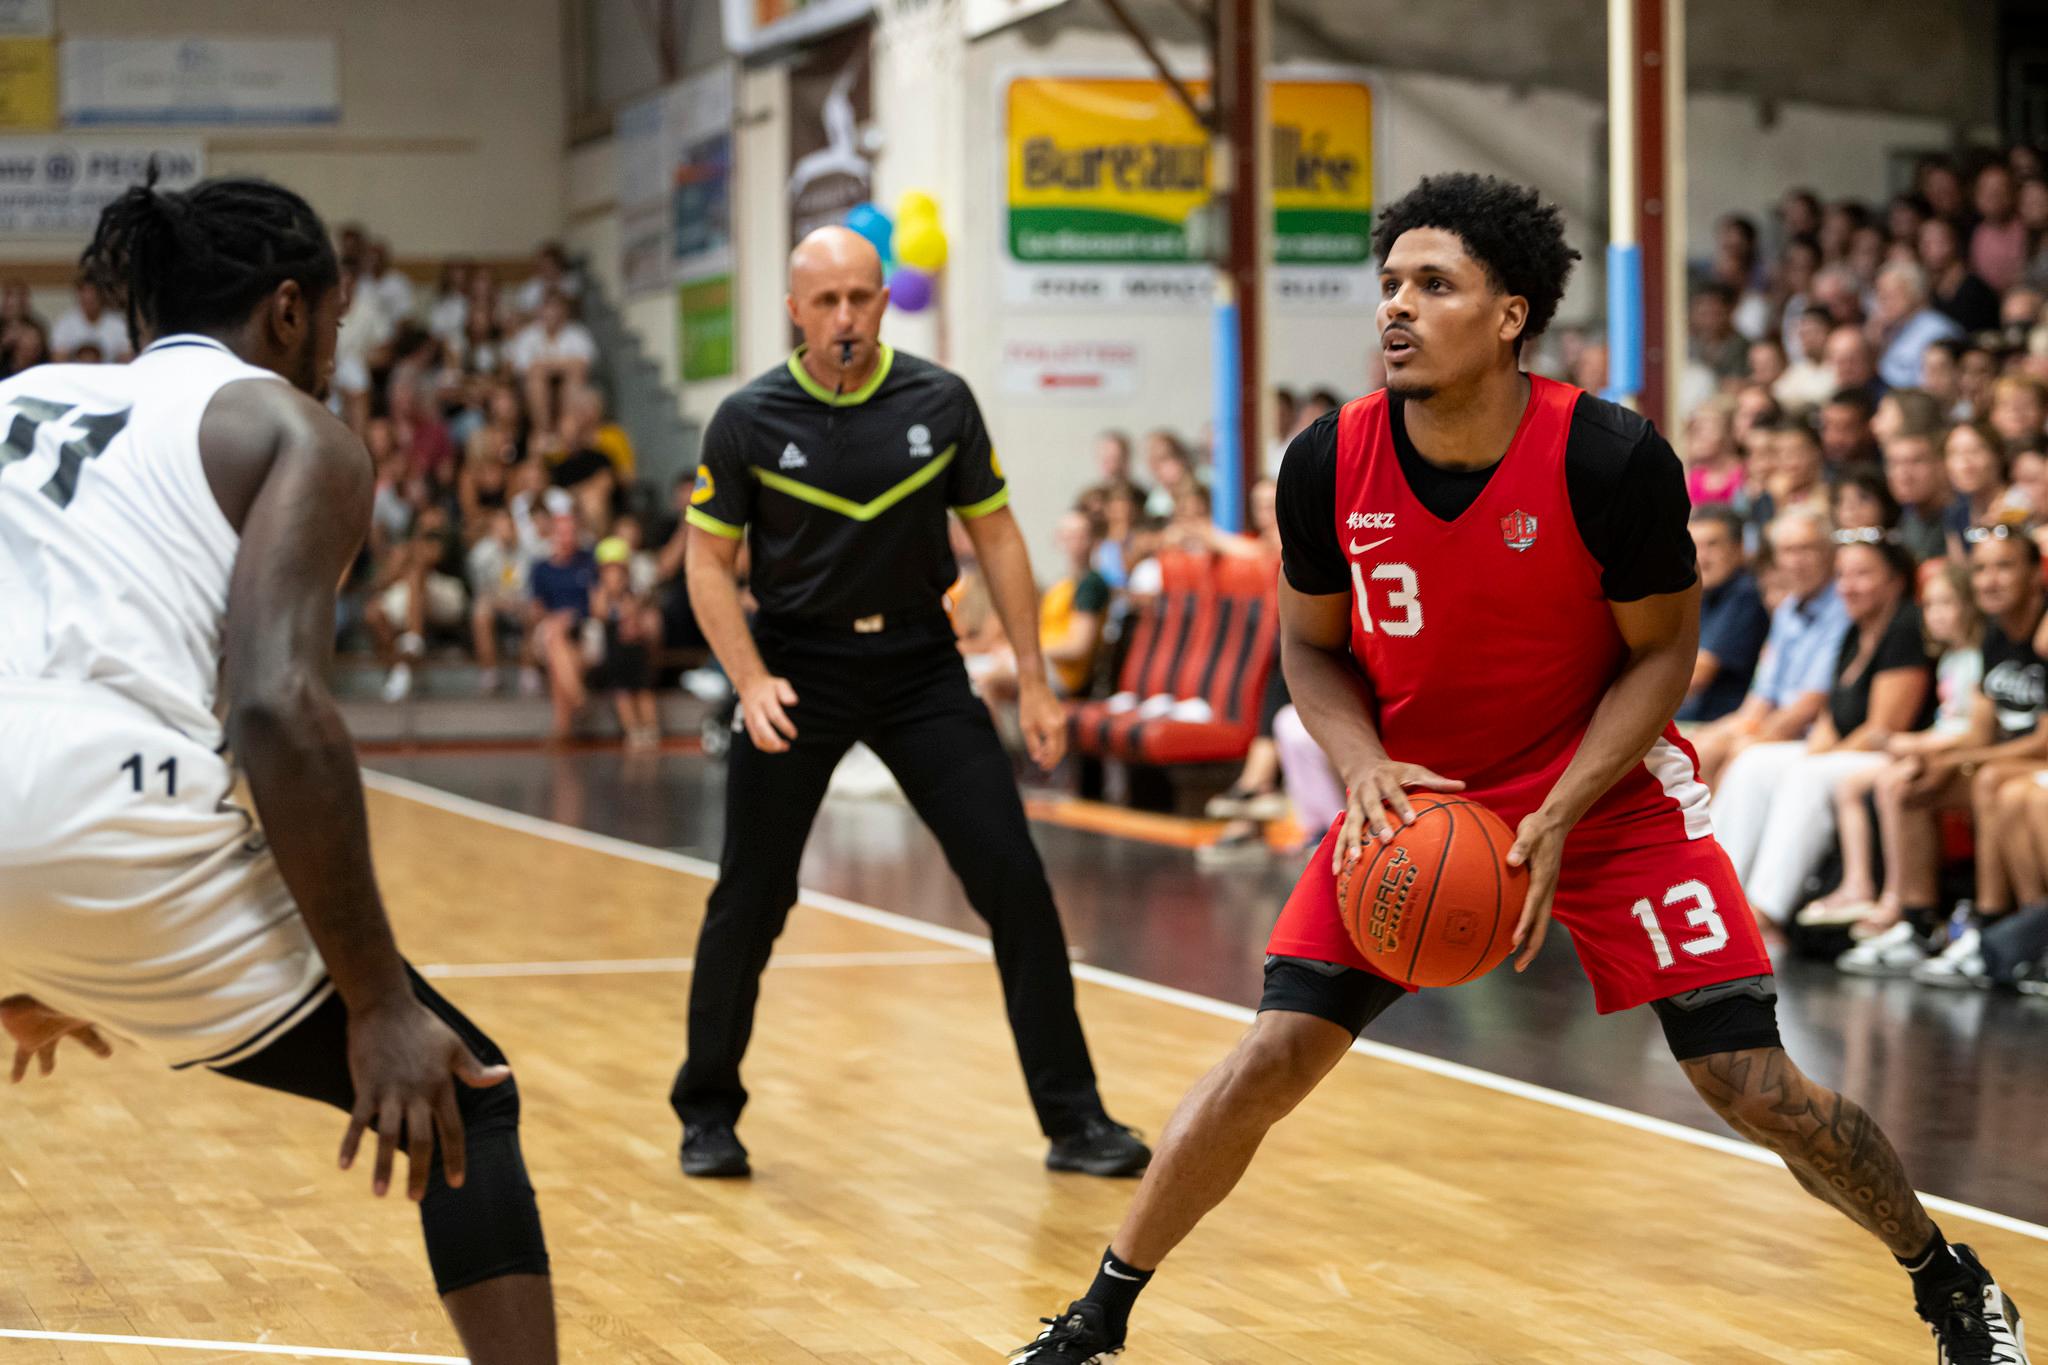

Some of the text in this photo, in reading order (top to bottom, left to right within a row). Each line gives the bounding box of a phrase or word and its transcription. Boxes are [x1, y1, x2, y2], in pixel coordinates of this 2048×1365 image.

[1022, 136, 1206, 193] Bureau
[1351, 561, 1425, 637] 13
[120, 752, 177, 797] 11
[1368, 847, 1409, 955] LEGACY
[1631, 878, 1730, 970] 13
